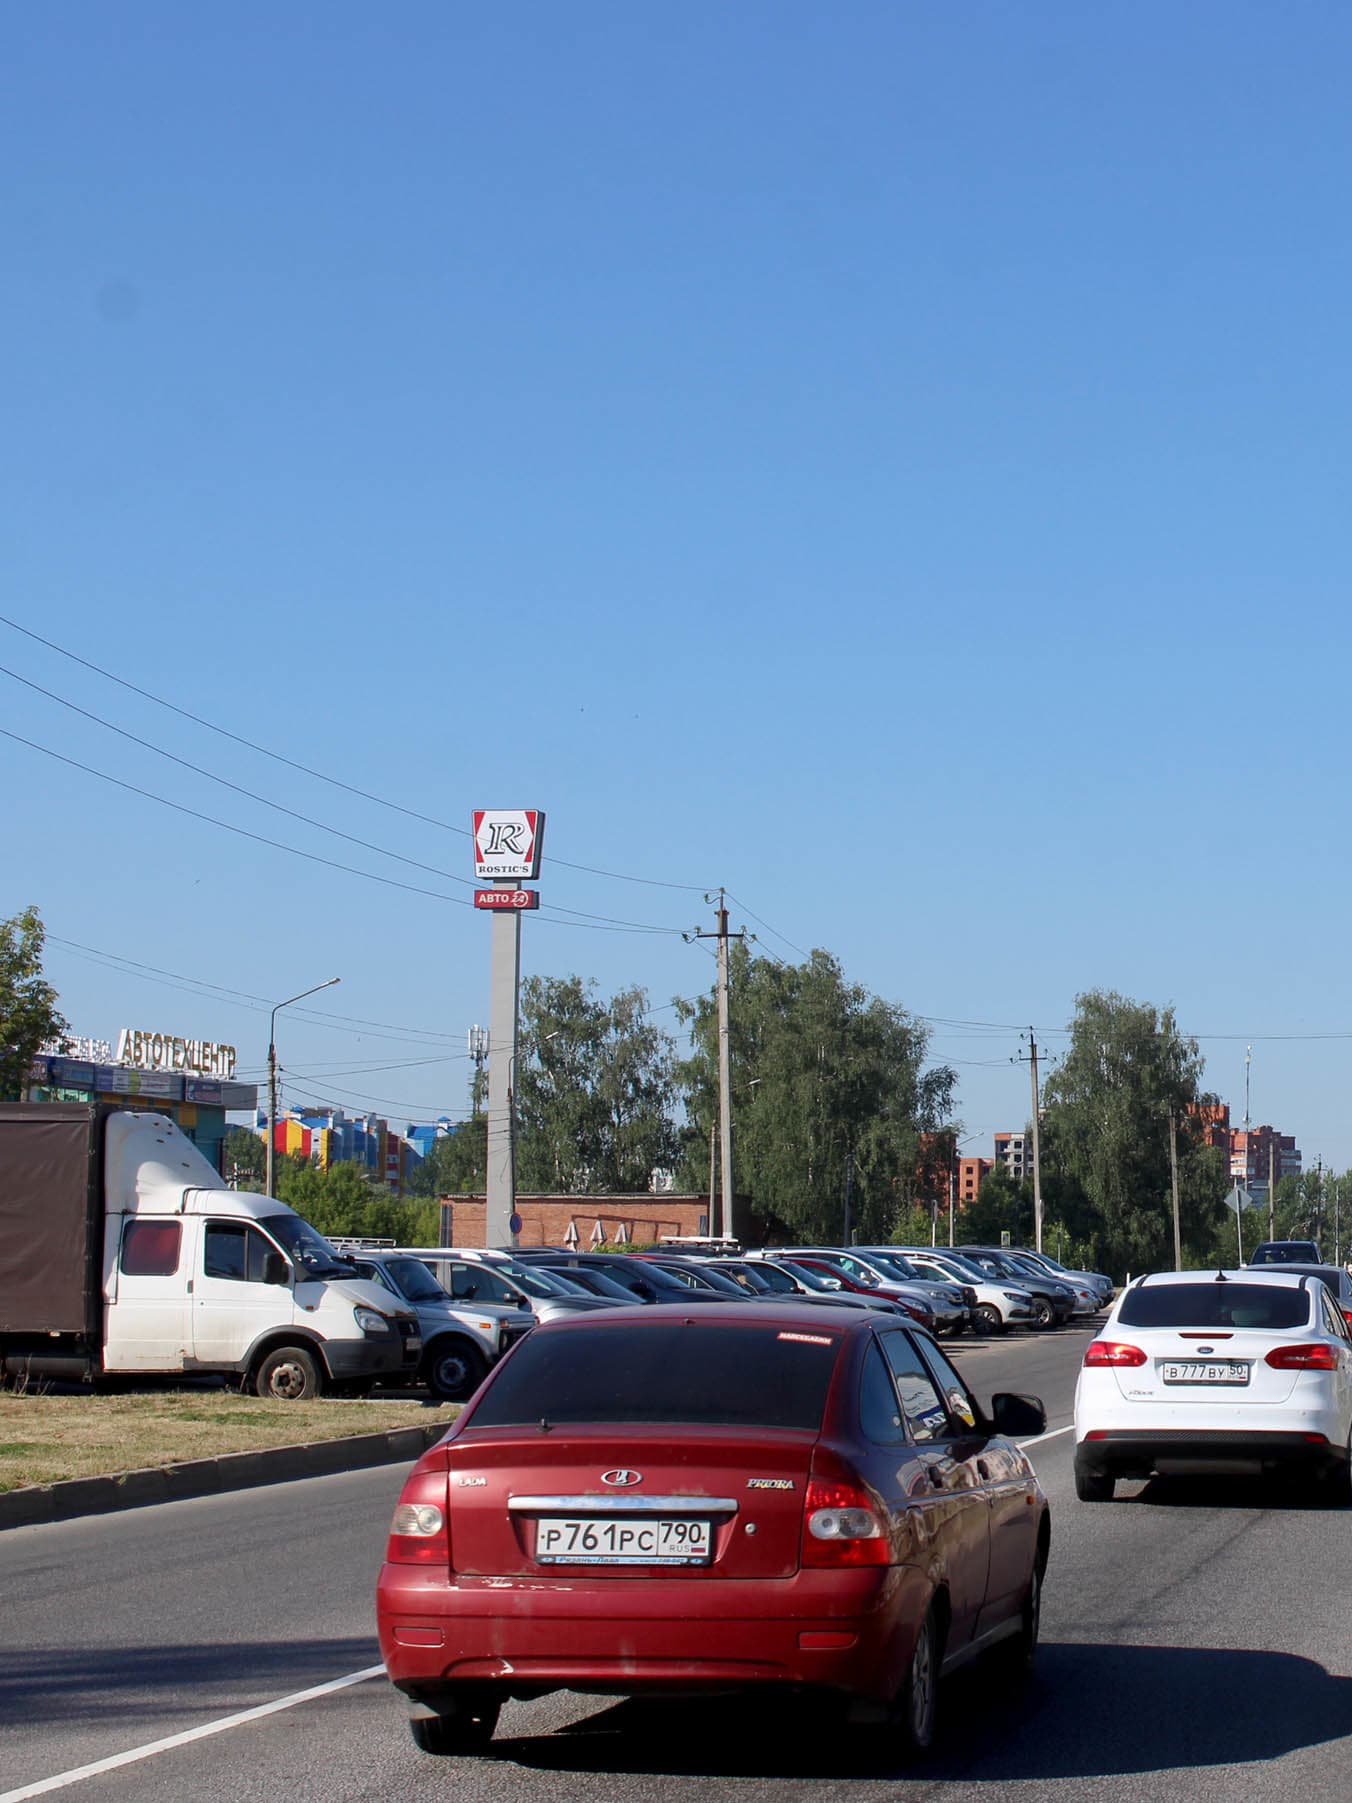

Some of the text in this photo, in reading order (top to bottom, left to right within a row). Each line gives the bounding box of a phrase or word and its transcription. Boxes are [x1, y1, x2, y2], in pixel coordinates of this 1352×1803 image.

[479, 865, 529, 873] ROSTIC'S
[478, 893, 510, 903] АВТО
[119, 1028, 237, 1075] АВТОТЕХЦЕНТР
[1170, 1365, 1244, 1378] В777ВУ 50
[459, 1477, 487, 1487] LADA
[747, 1478, 795, 1489] PRIORA
[546, 1522, 701, 1551] Р761РС 790
[669, 1545, 690, 1553] RUS
